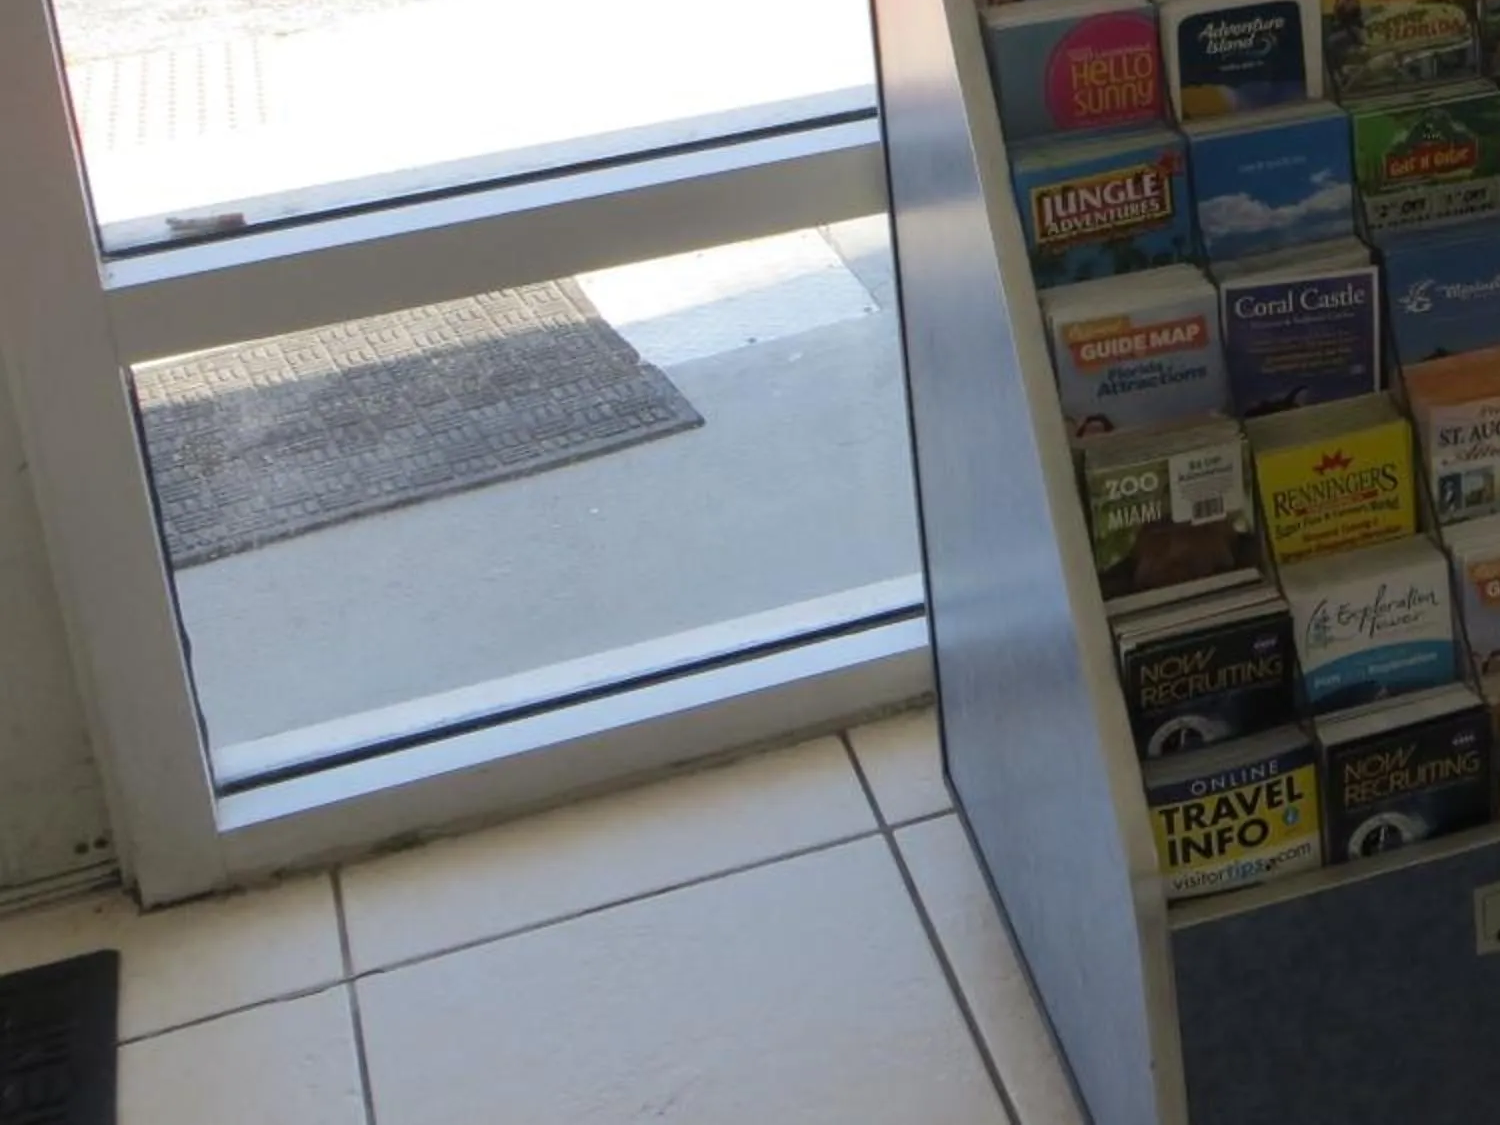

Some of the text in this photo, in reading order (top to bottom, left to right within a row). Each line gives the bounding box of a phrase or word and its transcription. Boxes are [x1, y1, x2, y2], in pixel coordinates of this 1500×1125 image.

[1043, 172, 1161, 225] JUNGLE
[1047, 199, 1161, 236] ADVENTURES
[1235, 282, 1366, 319] Coral Castle
[1079, 323, 1201, 362] GUIDE MAP
[1438, 426, 1466, 449] ST.
[1105, 470, 1160, 501] ZOO
[1272, 462, 1399, 519] RENNINGERS
[1108, 499, 1163, 532] MIAMI
[1337, 583, 1441, 633] Exploration
[1141, 644, 1217, 685] NOW
[1141, 655, 1283, 712] RECRUITING
[1190, 758, 1279, 796] ONLINE
[1344, 744, 1417, 783] NOW
[1344, 750, 1480, 807] RECRUITING
[1158, 775, 1303, 836] TRAVEL
[1168, 816, 1270, 867] INFO
[1171, 841, 1312, 892] visitortips.com
